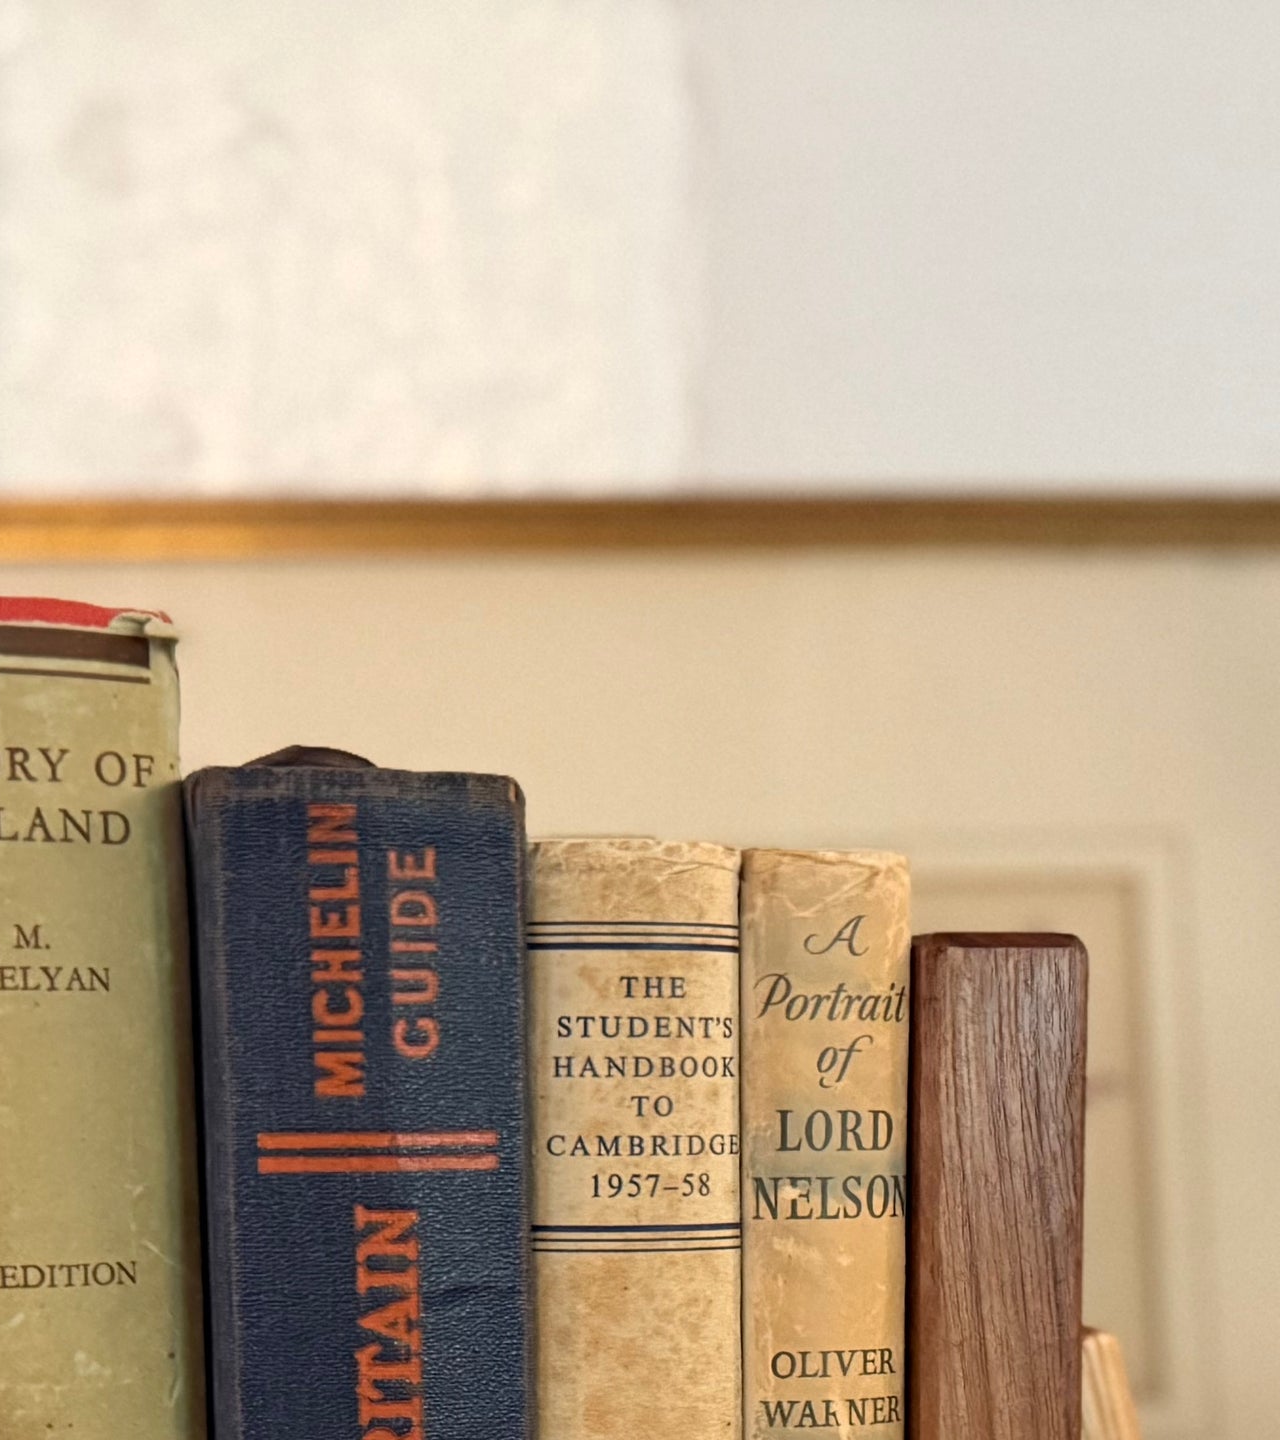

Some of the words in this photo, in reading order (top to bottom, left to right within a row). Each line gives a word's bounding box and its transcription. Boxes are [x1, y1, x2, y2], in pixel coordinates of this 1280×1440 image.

[94, 750, 155, 788] OF
[13, 923, 52, 951] M.
[306, 802, 366, 1098] MICHELIN
[387, 845, 441, 1060] GUIDE
[803, 914, 870, 958] A
[619, 975, 687, 999] THE
[752, 972, 907, 1024] Portrait
[556, 1015, 734, 1039] STUDENT'S
[552, 1055, 736, 1079] HANDBOOK
[816, 1034, 874, 1089] of
[630, 1095, 674, 1118] TO
[545, 1133, 740, 1158] CAMBRIDGE
[774, 1108, 894, 1153] LORD
[752, 1174, 908, 1221] NELSON
[770, 1347, 897, 1379] OLIVER
